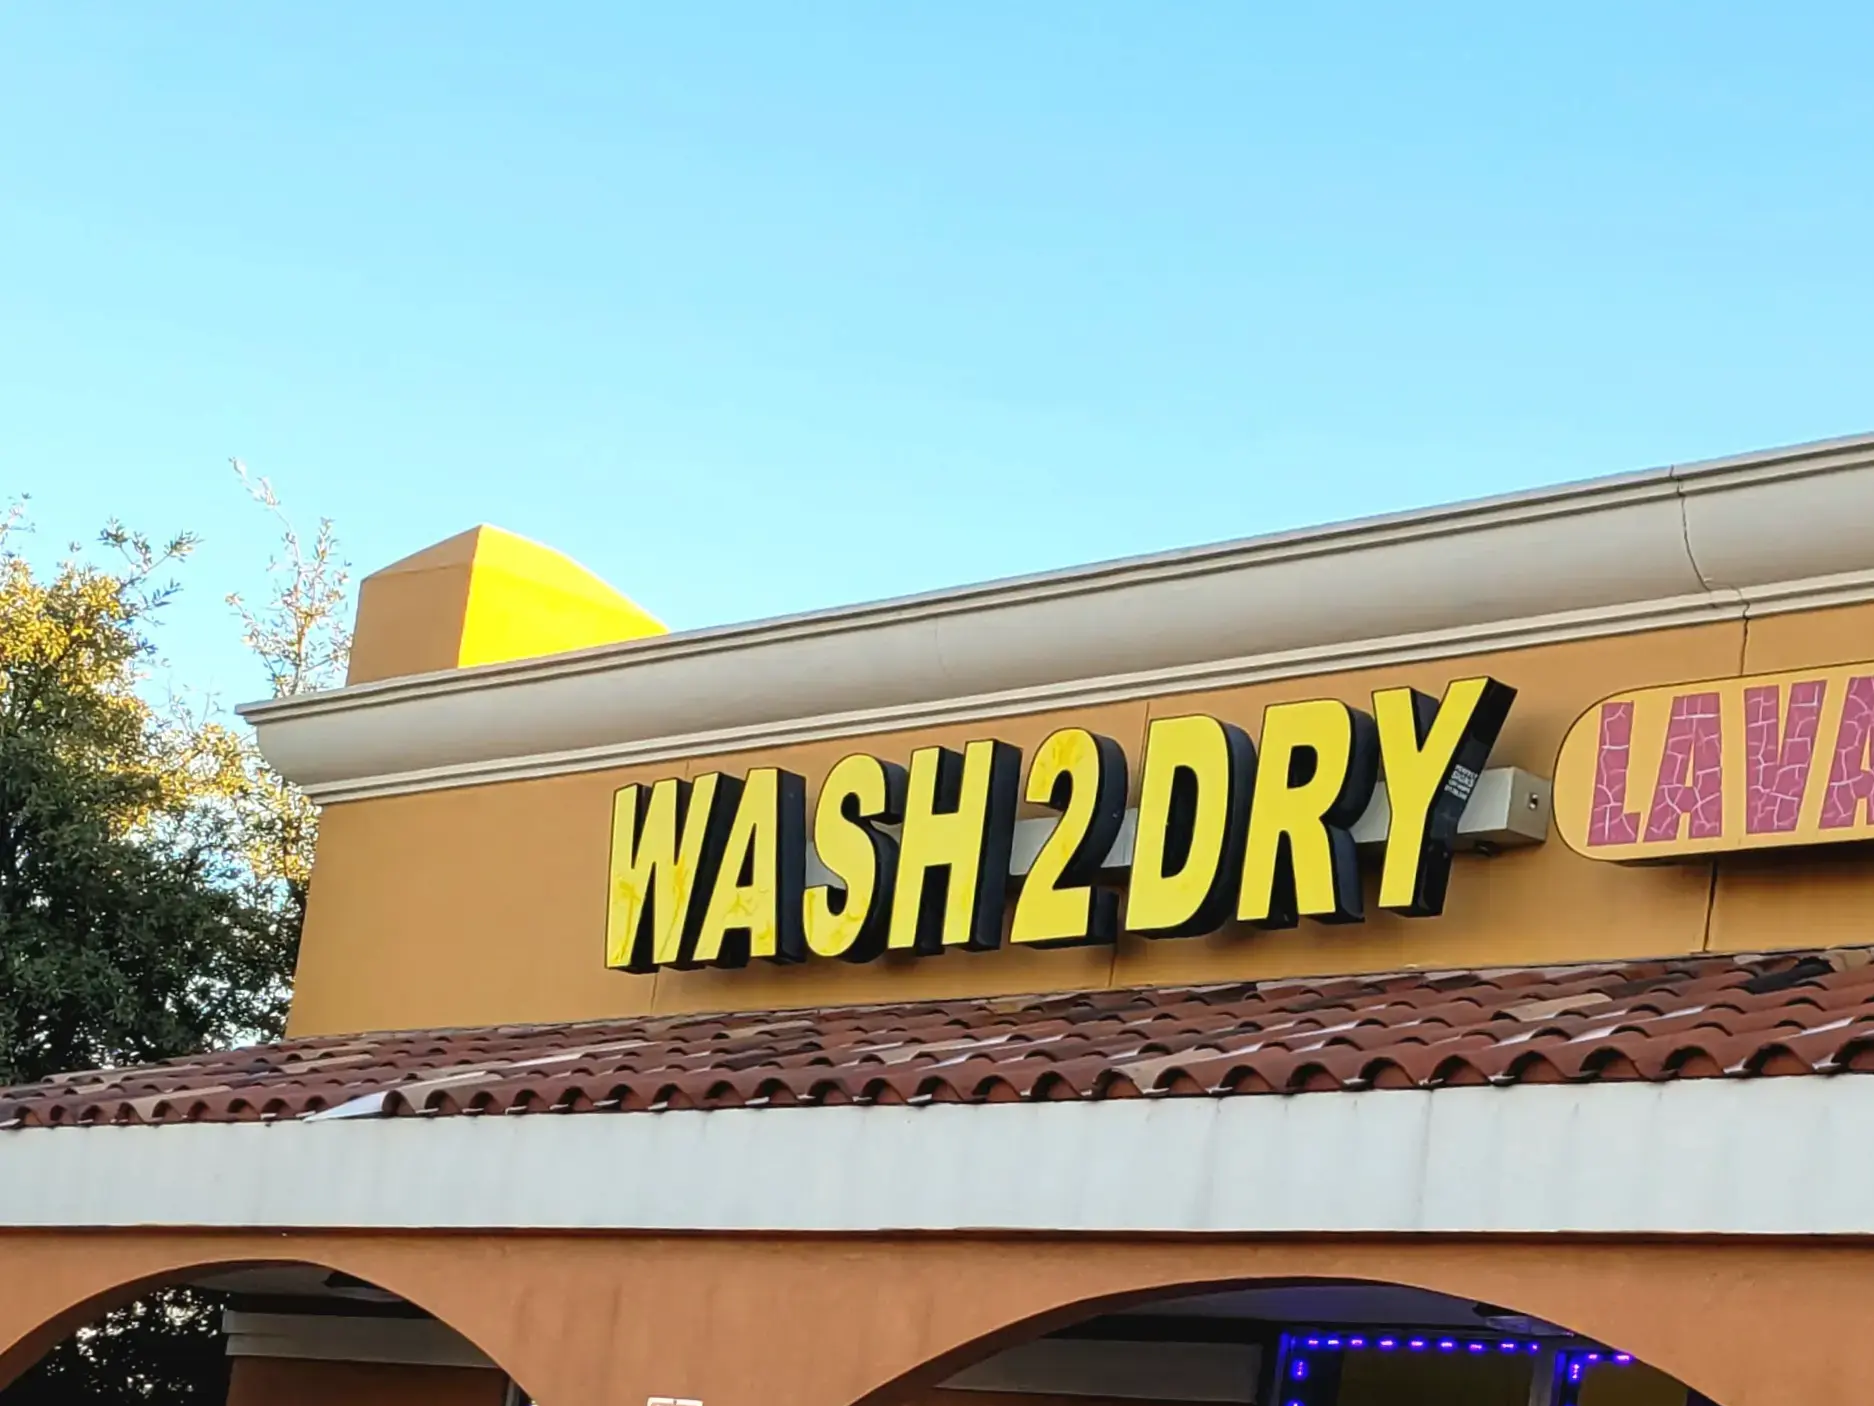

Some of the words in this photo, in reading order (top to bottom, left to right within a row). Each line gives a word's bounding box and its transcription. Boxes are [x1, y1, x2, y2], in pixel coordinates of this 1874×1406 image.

[605, 738, 1021, 974] WASH
[1010, 727, 1128, 949] 2
[1125, 676, 1517, 938] DRY
